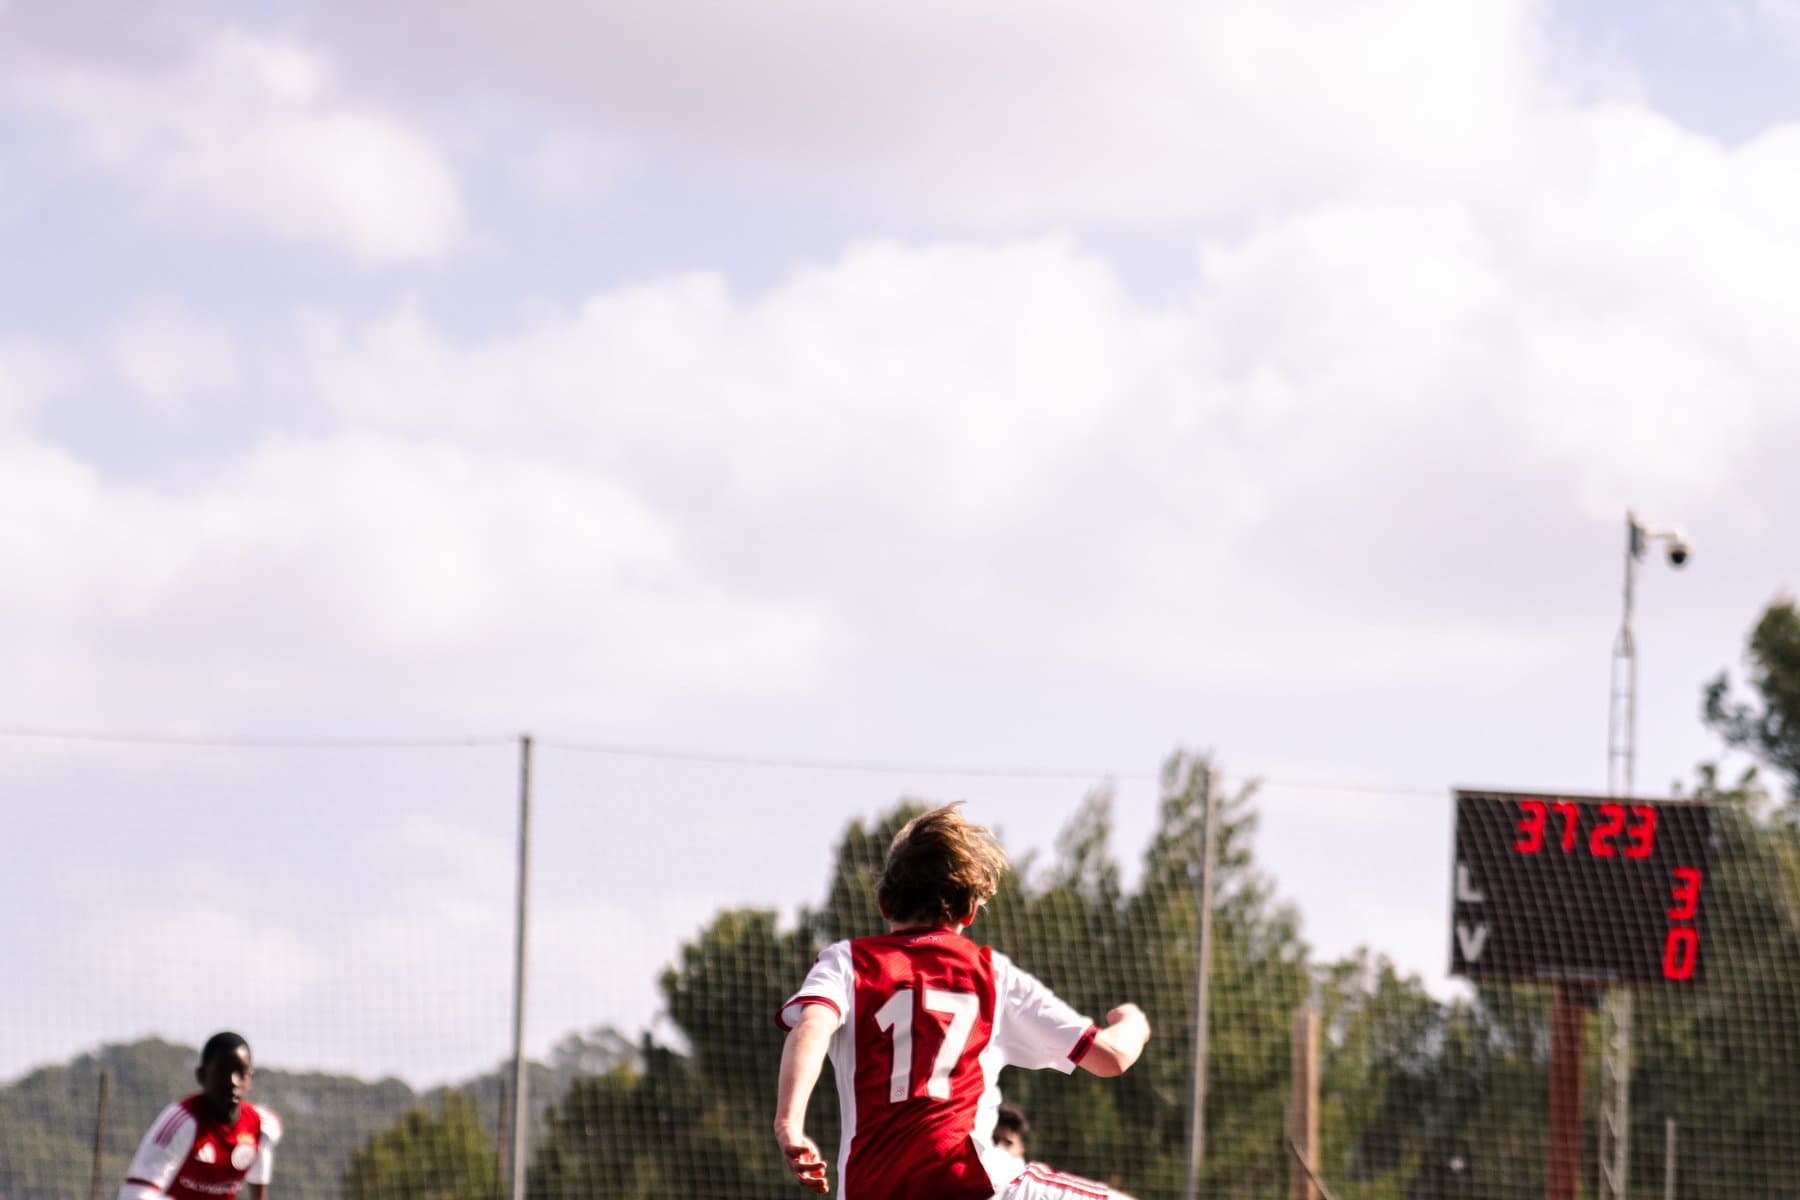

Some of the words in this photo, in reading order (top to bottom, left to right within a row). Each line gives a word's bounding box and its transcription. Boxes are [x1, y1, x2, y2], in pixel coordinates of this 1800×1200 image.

[1513, 798, 1580, 854] 37
[1589, 803, 1658, 860] 23
[1457, 864, 1484, 901] L
[1667, 865, 1702, 921] 3
[1456, 924, 1488, 963] V
[1661, 925, 1700, 980] 0
[874, 987, 980, 1103] 17
